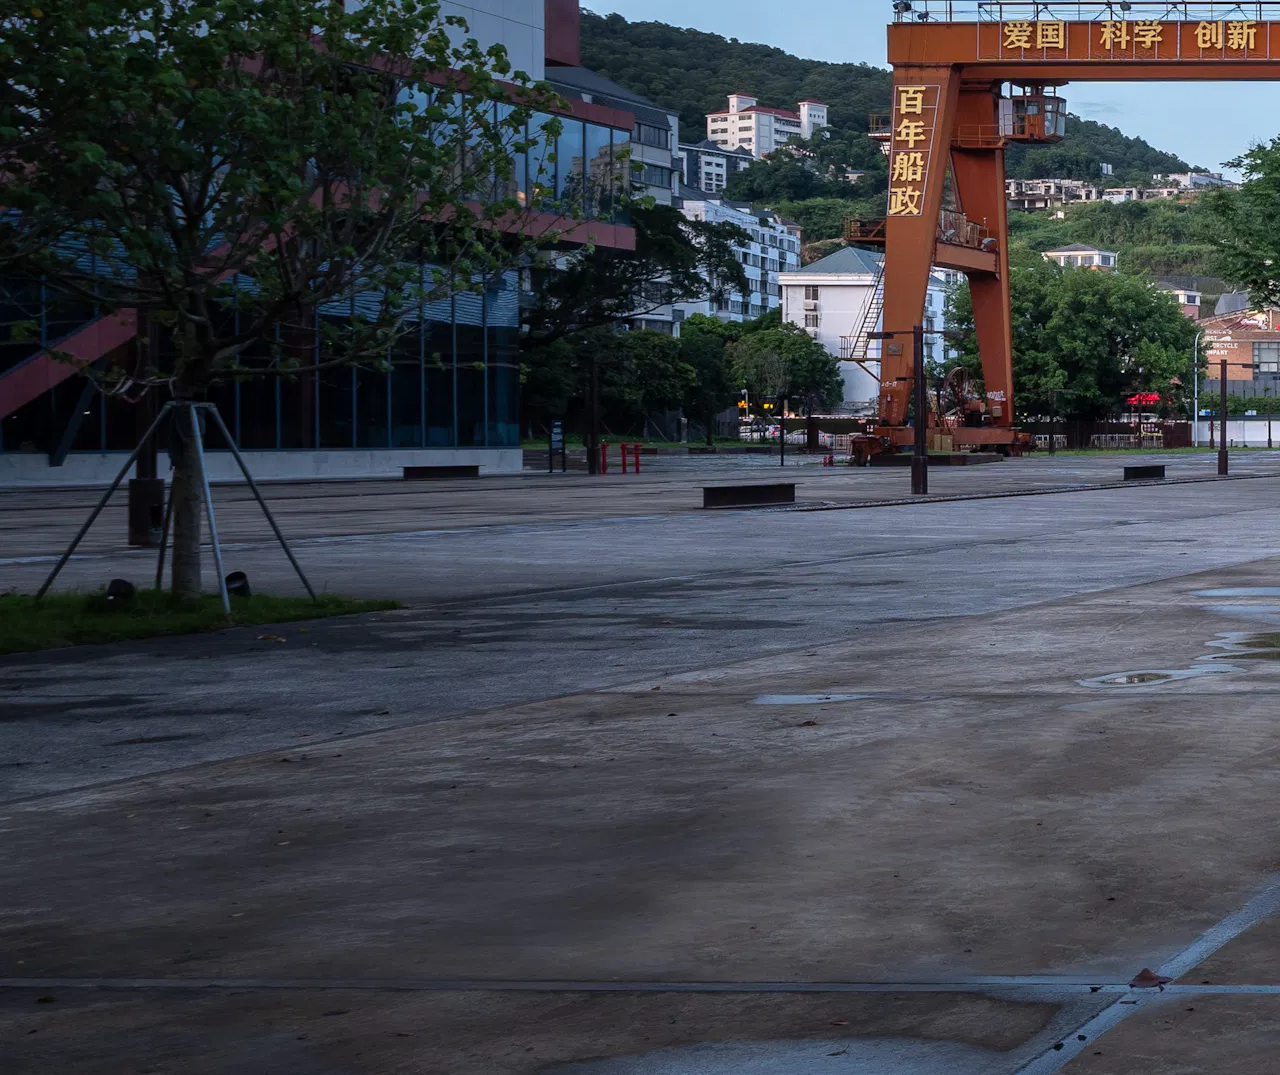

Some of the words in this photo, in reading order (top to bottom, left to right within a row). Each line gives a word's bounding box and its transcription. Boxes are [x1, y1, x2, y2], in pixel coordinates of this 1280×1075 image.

[1003, 20, 1065, 50] 爱国
[1100, 19, 1163, 50] 科学
[1194, 20, 1256, 50] 创新
[888, 86, 927, 215] 百年船政
